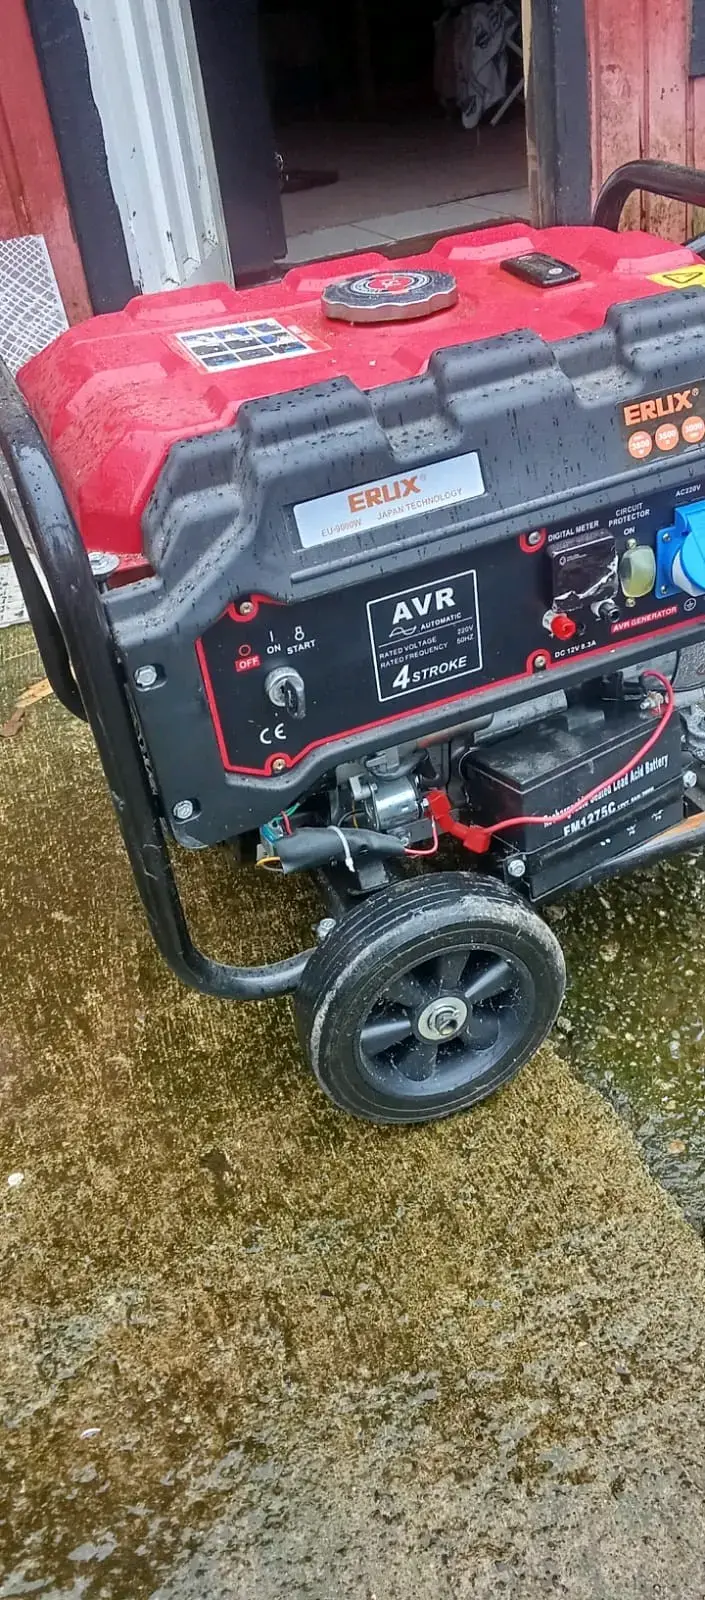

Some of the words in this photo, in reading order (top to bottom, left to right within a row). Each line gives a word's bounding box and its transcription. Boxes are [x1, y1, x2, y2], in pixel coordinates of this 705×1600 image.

[675, 484, 701, 497] AC220V
[377, 505, 404, 521] JAPAN
[405, 488, 462, 511] TECHNOLOGY
[615, 502, 643, 517] CIRCUIT
[608, 509, 650, 527] PROTECTOR
[548, 528, 574, 542] DIGITAL
[575, 520, 599, 533] METER
[623, 526, 635, 536] ON
[392, 587, 456, 625] AVR
[420, 612, 462, 631] AUTOMATIC
[612, 621, 630, 633] AVR
[631, 606, 678, 627] GENERATOR
[266, 643, 281, 654] ON
[287, 639, 316, 655] START
[379, 647, 403, 660] RATED
[403, 636, 437, 652] VOLTAGE
[380, 657, 404, 669] RATED
[405, 642, 448, 661] FREQUENCY
[554, 647, 565, 658] DC
[567, 643, 580, 654] 12V
[239, 656, 259, 670] OFF
[392, 664, 410, 689] 4
[412, 655, 468, 682] STROKE
[613, 773, 629, 792] Lead
[630, 764, 644, 783] Acid
[645, 754, 669, 775] Battery
[563, 801, 616, 837] FM1275C
